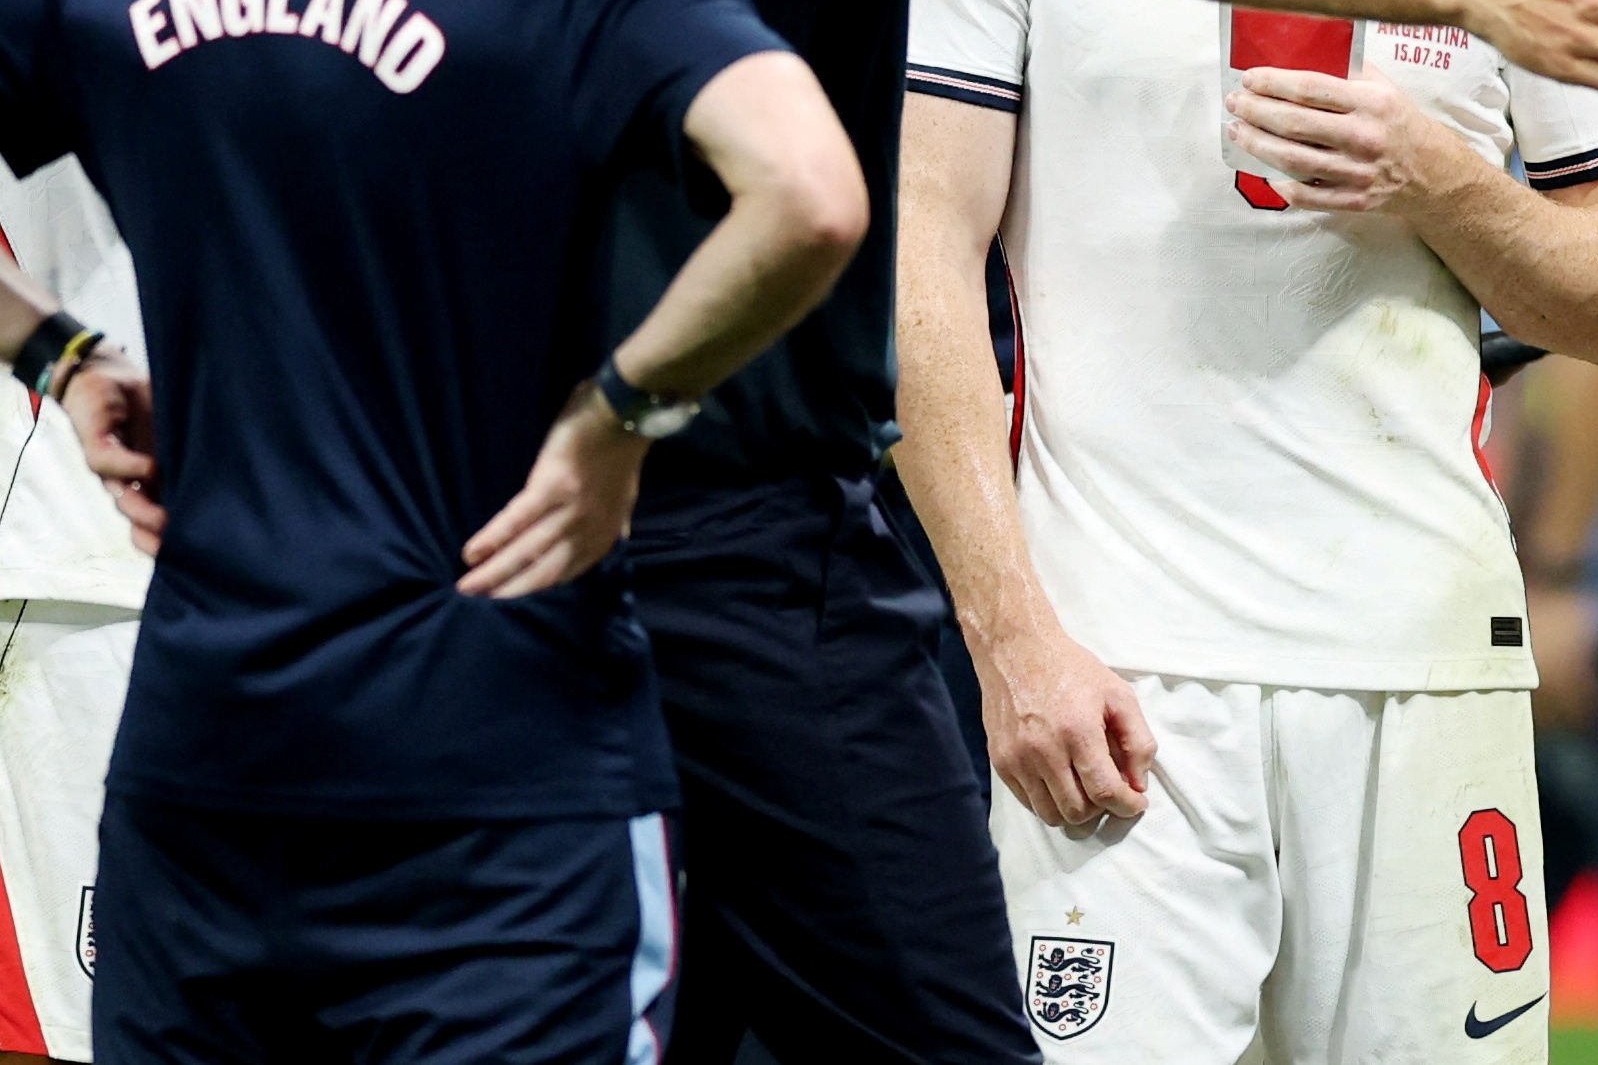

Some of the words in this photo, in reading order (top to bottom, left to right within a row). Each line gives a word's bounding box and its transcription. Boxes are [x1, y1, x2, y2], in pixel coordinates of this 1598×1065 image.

[1377, 22, 1469, 49] ARGENTINA
[1394, 43, 1451, 70] 15.07.26
[1458, 807, 1534, 975] 8
